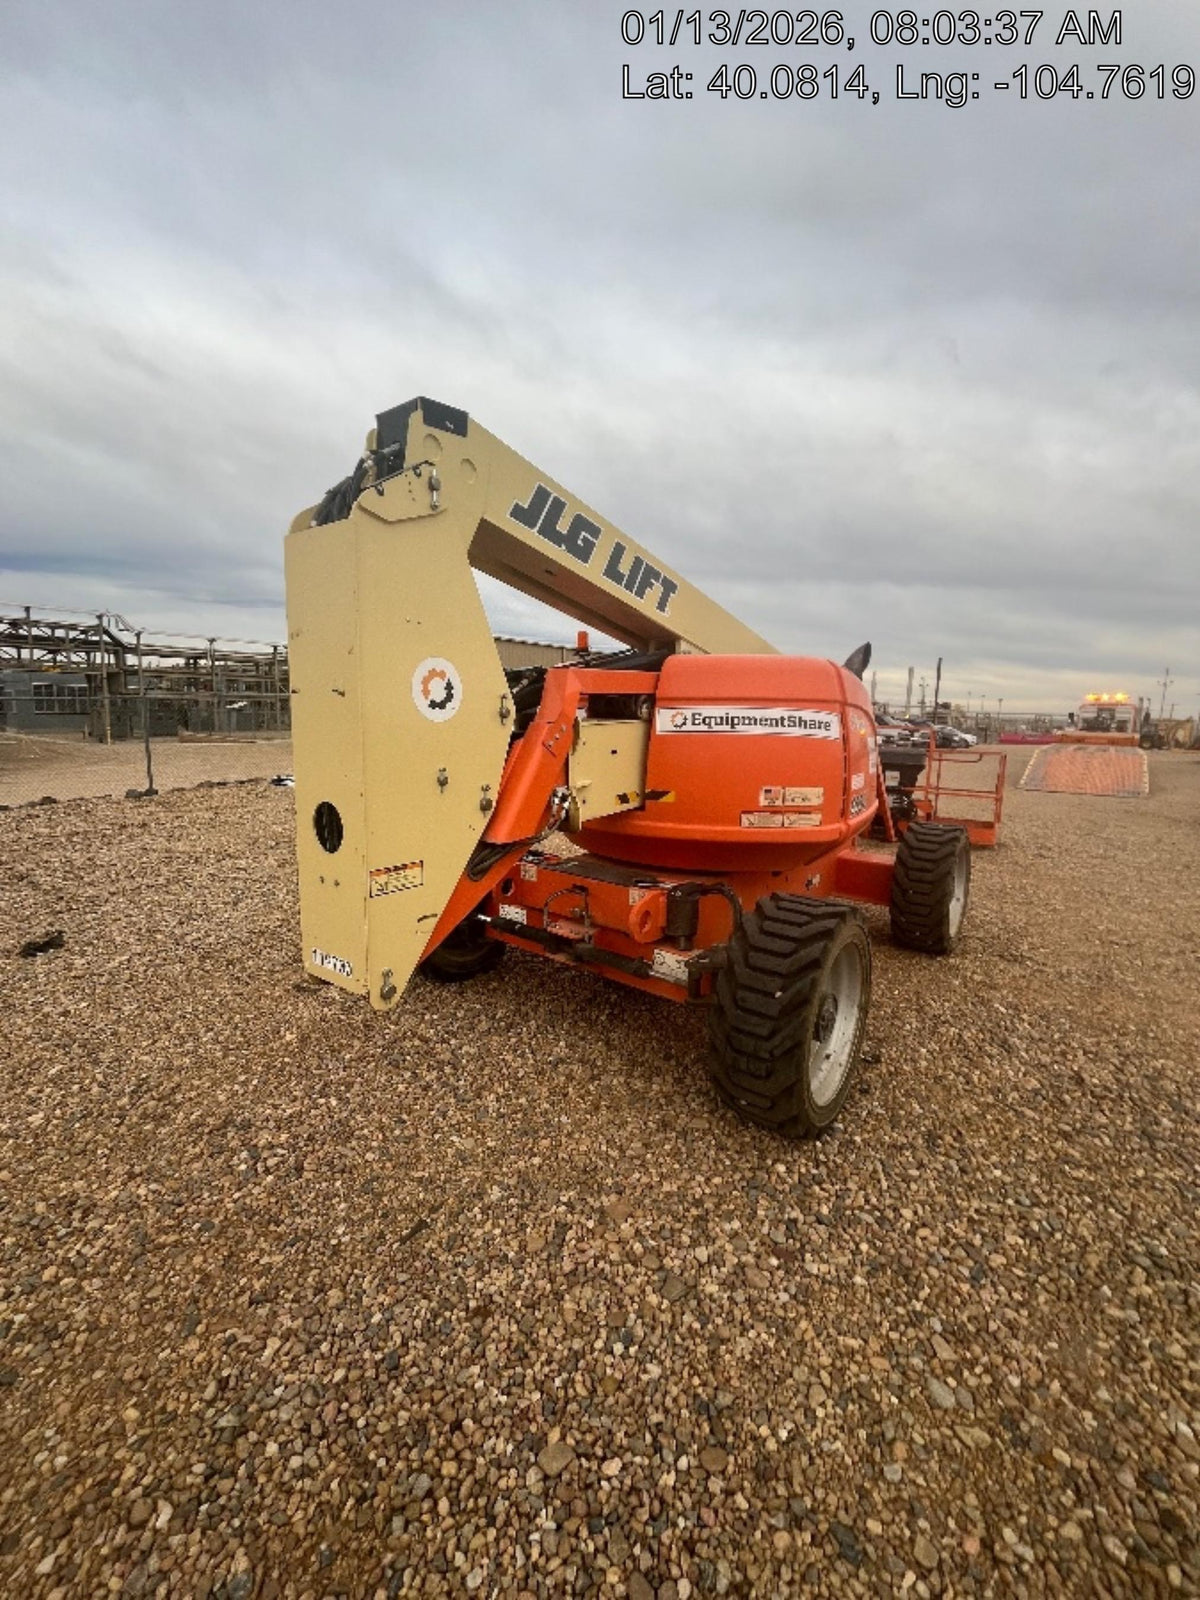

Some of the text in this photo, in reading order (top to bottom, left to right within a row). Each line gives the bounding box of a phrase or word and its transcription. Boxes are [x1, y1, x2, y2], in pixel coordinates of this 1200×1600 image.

[507, 482, 678, 616] JLG LIFT
[690, 711, 832, 732] EquipmentShare
